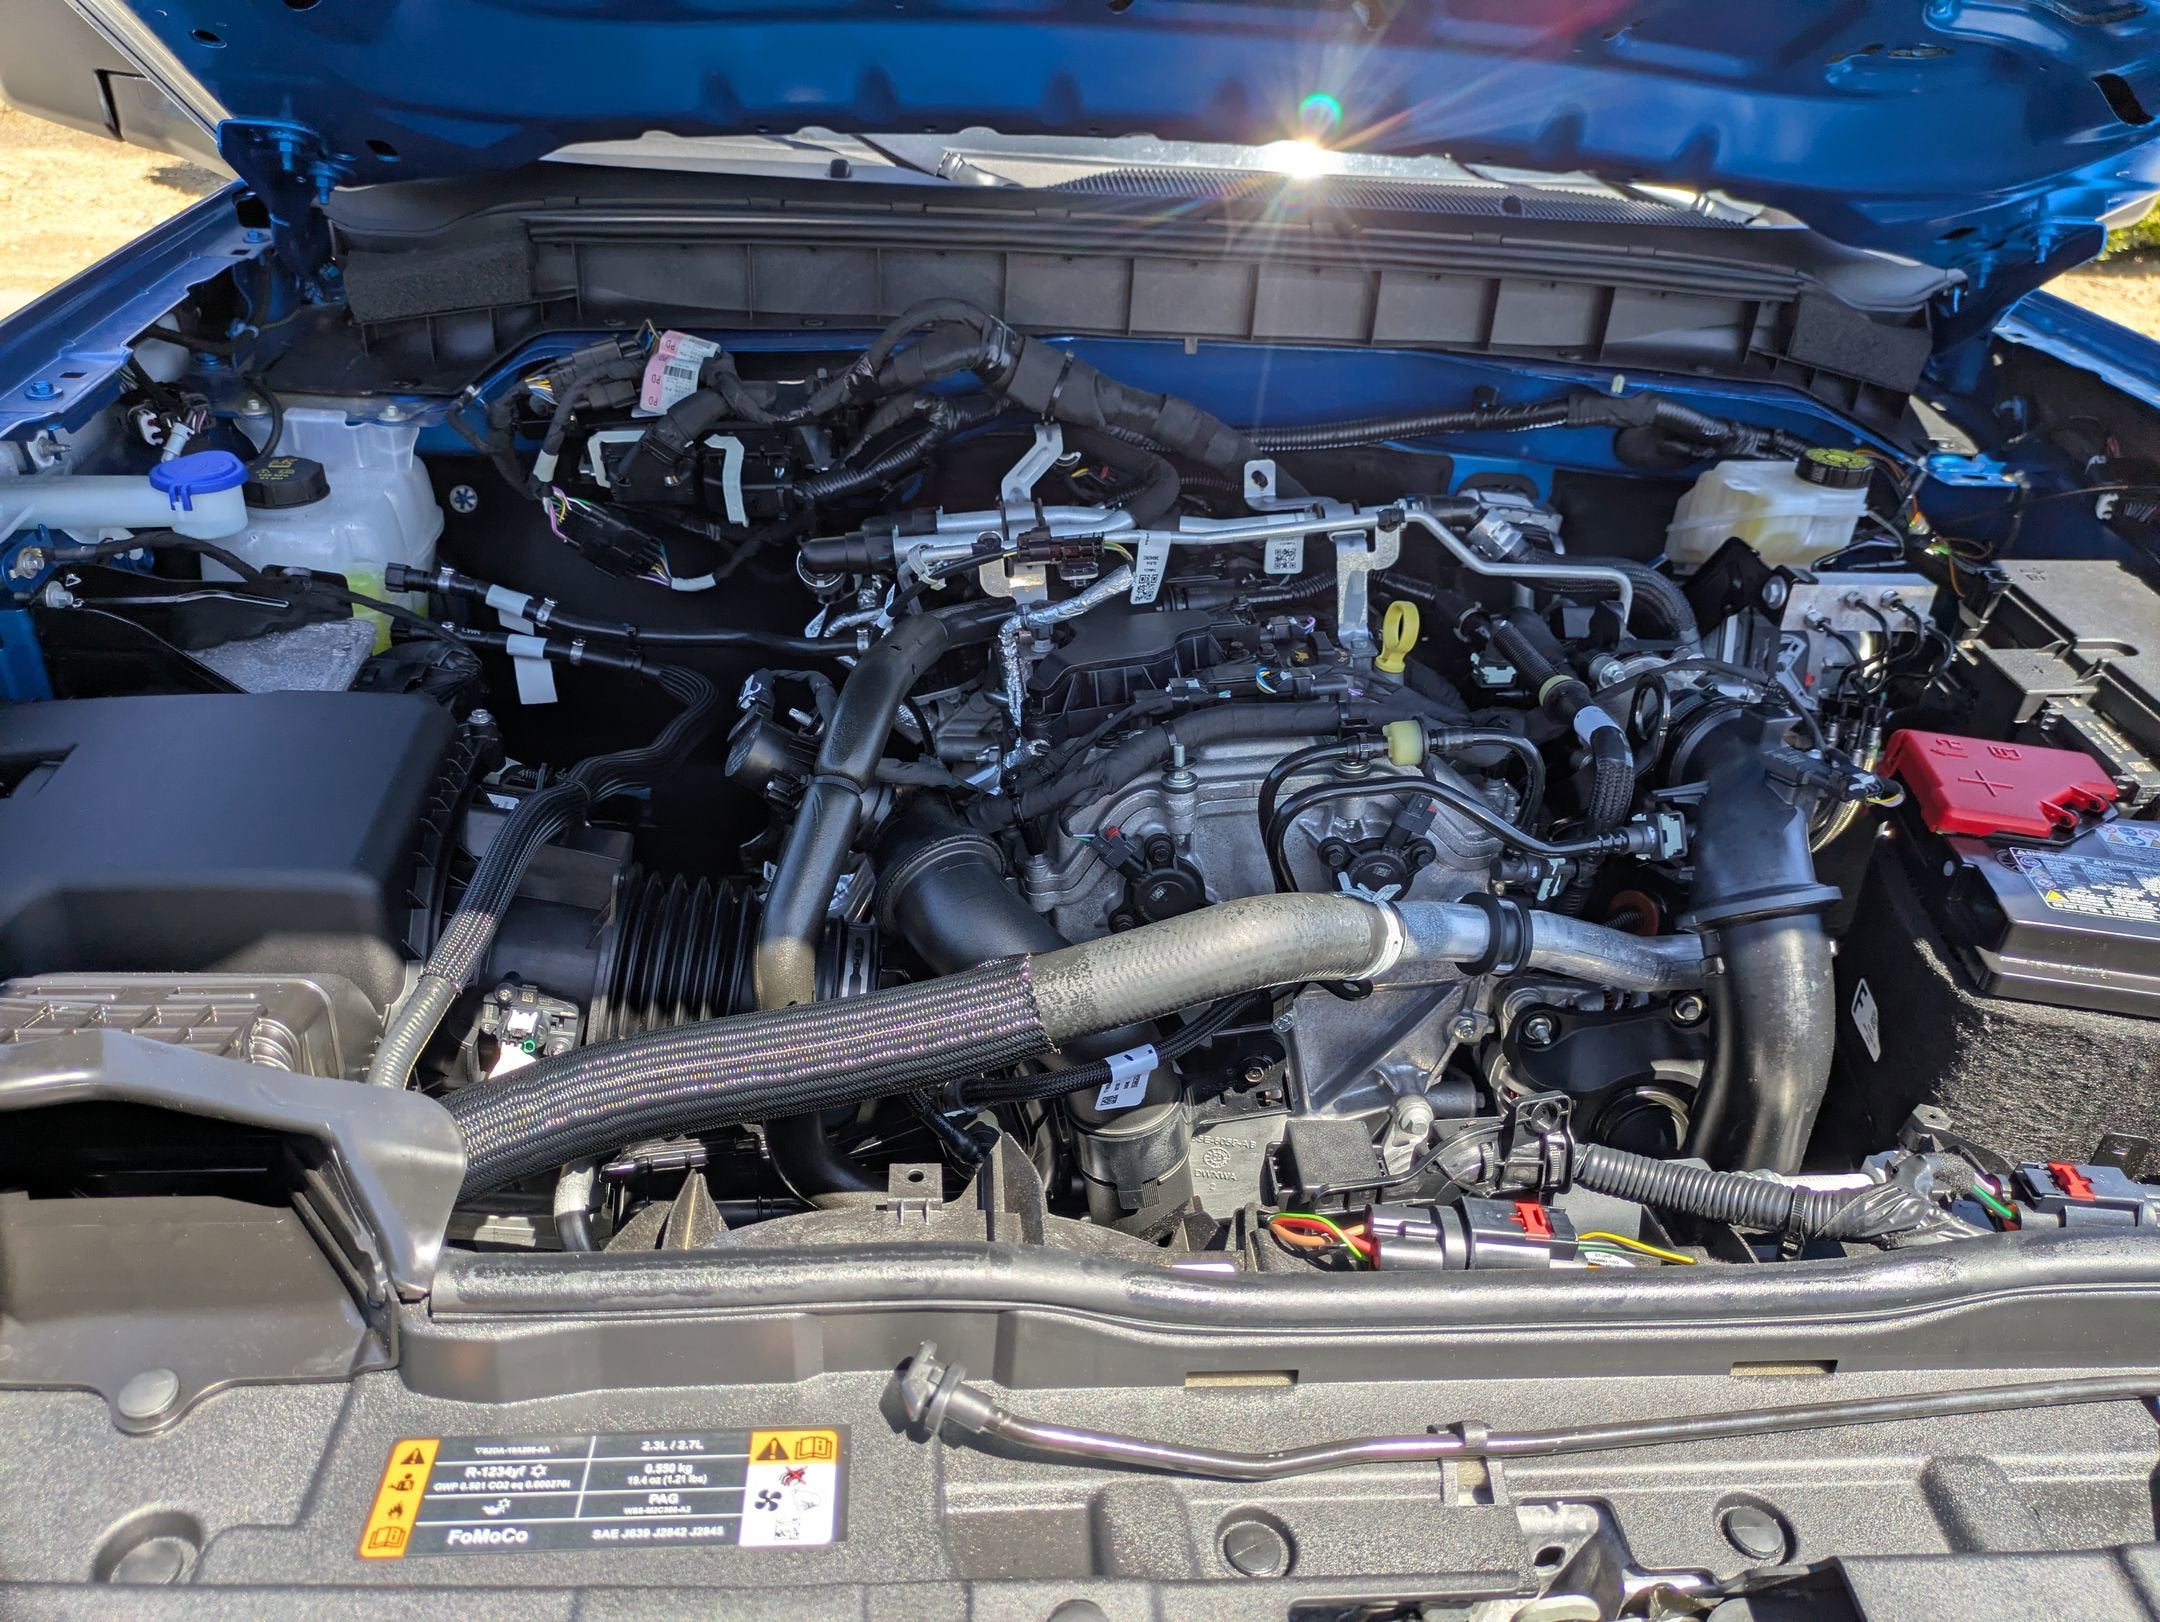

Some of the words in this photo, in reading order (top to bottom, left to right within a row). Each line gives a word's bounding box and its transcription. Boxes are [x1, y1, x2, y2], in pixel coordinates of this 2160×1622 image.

[648, 396, 659, 407] PD
[641, 1441, 668, 1452] 2.3L
[677, 1440, 704, 1450] 2.7L
[464, 1465, 526, 1479] R-1234yf
[644, 1463, 676, 1474] 0.550
[678, 1463, 693, 1474] kg
[433, 1482, 458, 1492] GWP
[487, 1481, 510, 1490] CO2
[648, 1494, 679, 1505] PAG
[447, 1527, 529, 1545] FoMoCo
[592, 1528, 619, 1540] SAE
[621, 1528, 650, 1539] J639
[652, 1527, 687, 1538] J2842
[689, 1526, 724, 1538] J2845
